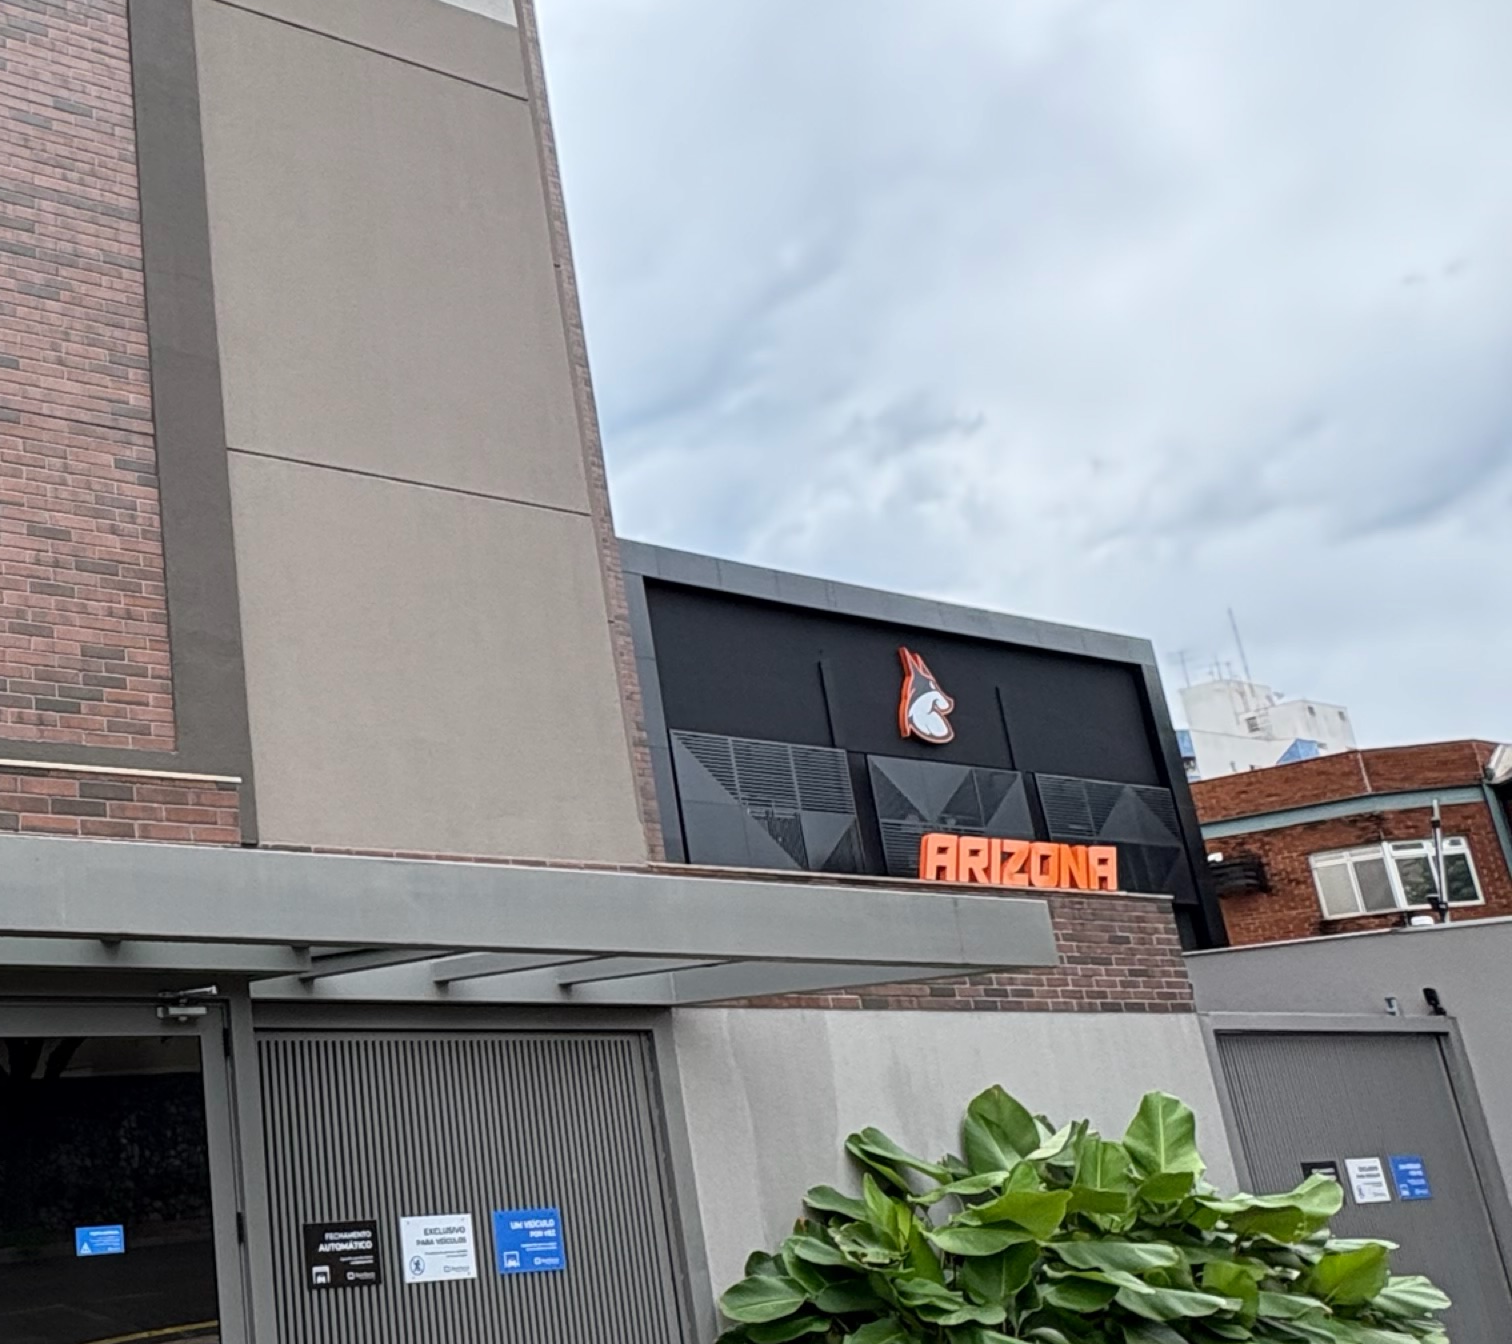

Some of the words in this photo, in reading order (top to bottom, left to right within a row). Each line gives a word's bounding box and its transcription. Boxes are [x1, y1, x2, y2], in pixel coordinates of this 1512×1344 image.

[919, 832, 1117, 891] ARIZONA
[324, 1230, 372, 1240] FECHAMENTO
[423, 1226, 466, 1236] EXCLUSIVO
[318, 1240, 373, 1252] AUTOMÁTICO
